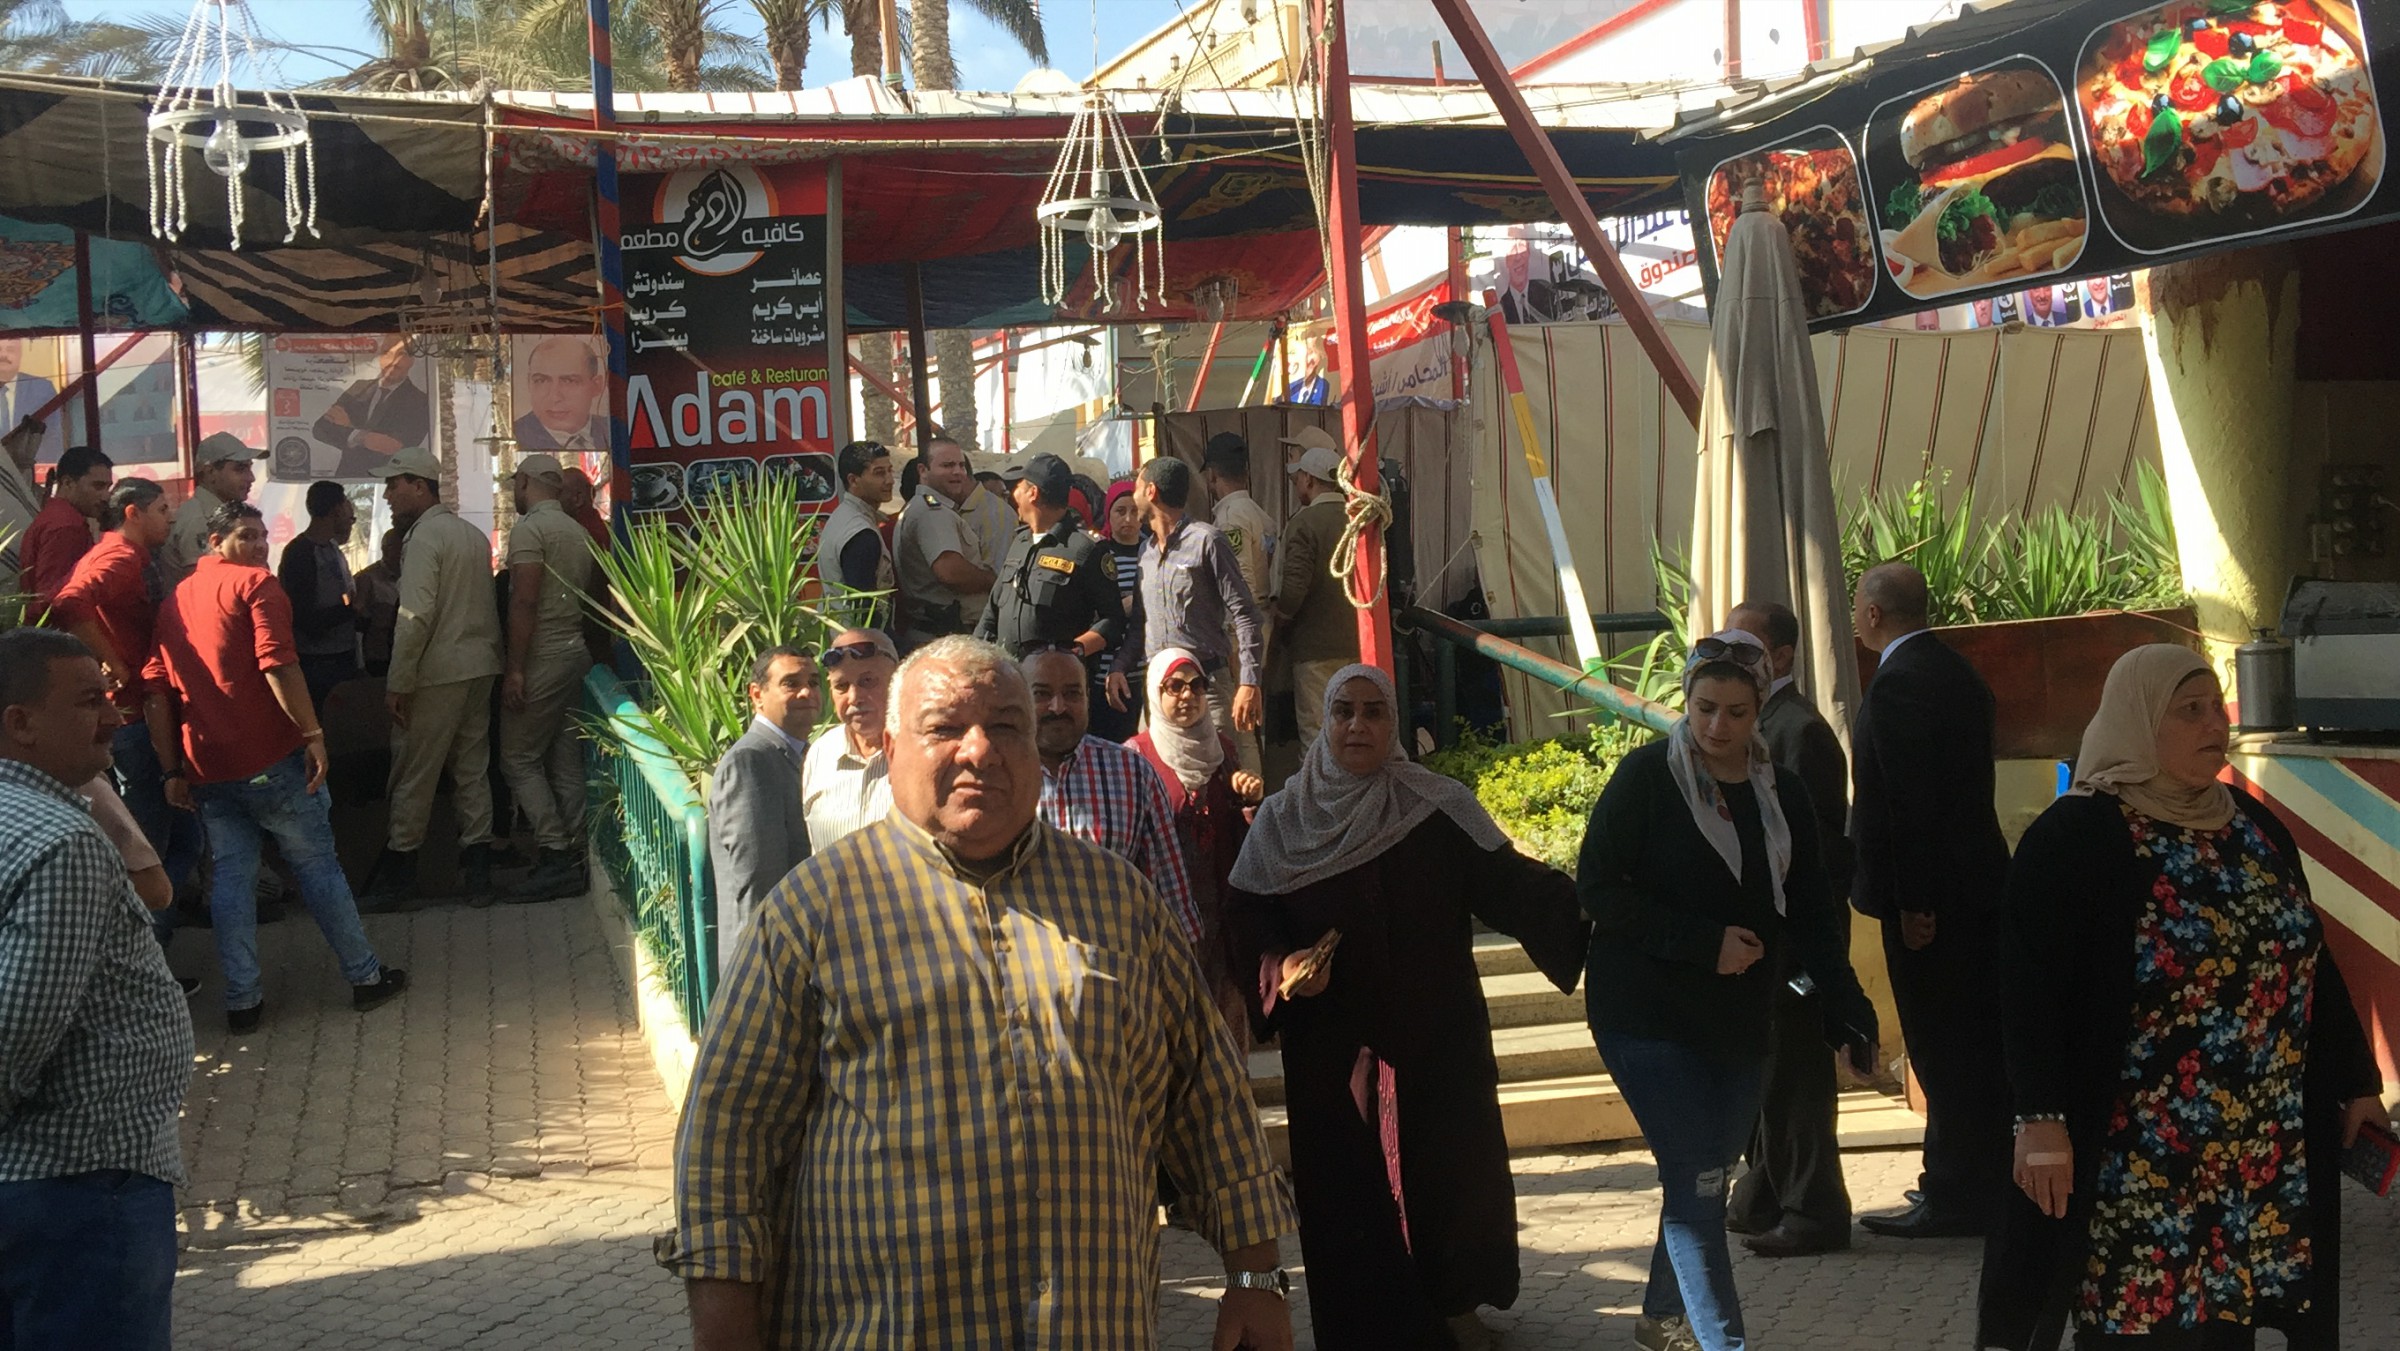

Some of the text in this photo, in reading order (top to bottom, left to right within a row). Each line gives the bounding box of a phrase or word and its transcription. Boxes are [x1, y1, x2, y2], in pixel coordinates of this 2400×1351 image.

[619, 229, 680, 251] مطعم
[741, 222, 804, 248] كافيه
[626, 270, 685, 299] سندوتش
[750, 267, 822, 293] عصائر
[629, 299, 687, 326] كريب
[752, 290, 824, 322] أيس كريم
[631, 327, 689, 354] بيتزا
[750, 324, 826, 347] مشروبات ساخنة
[711, 367, 830, 387] café & Resturan
[626, 370, 829, 449] Adam
